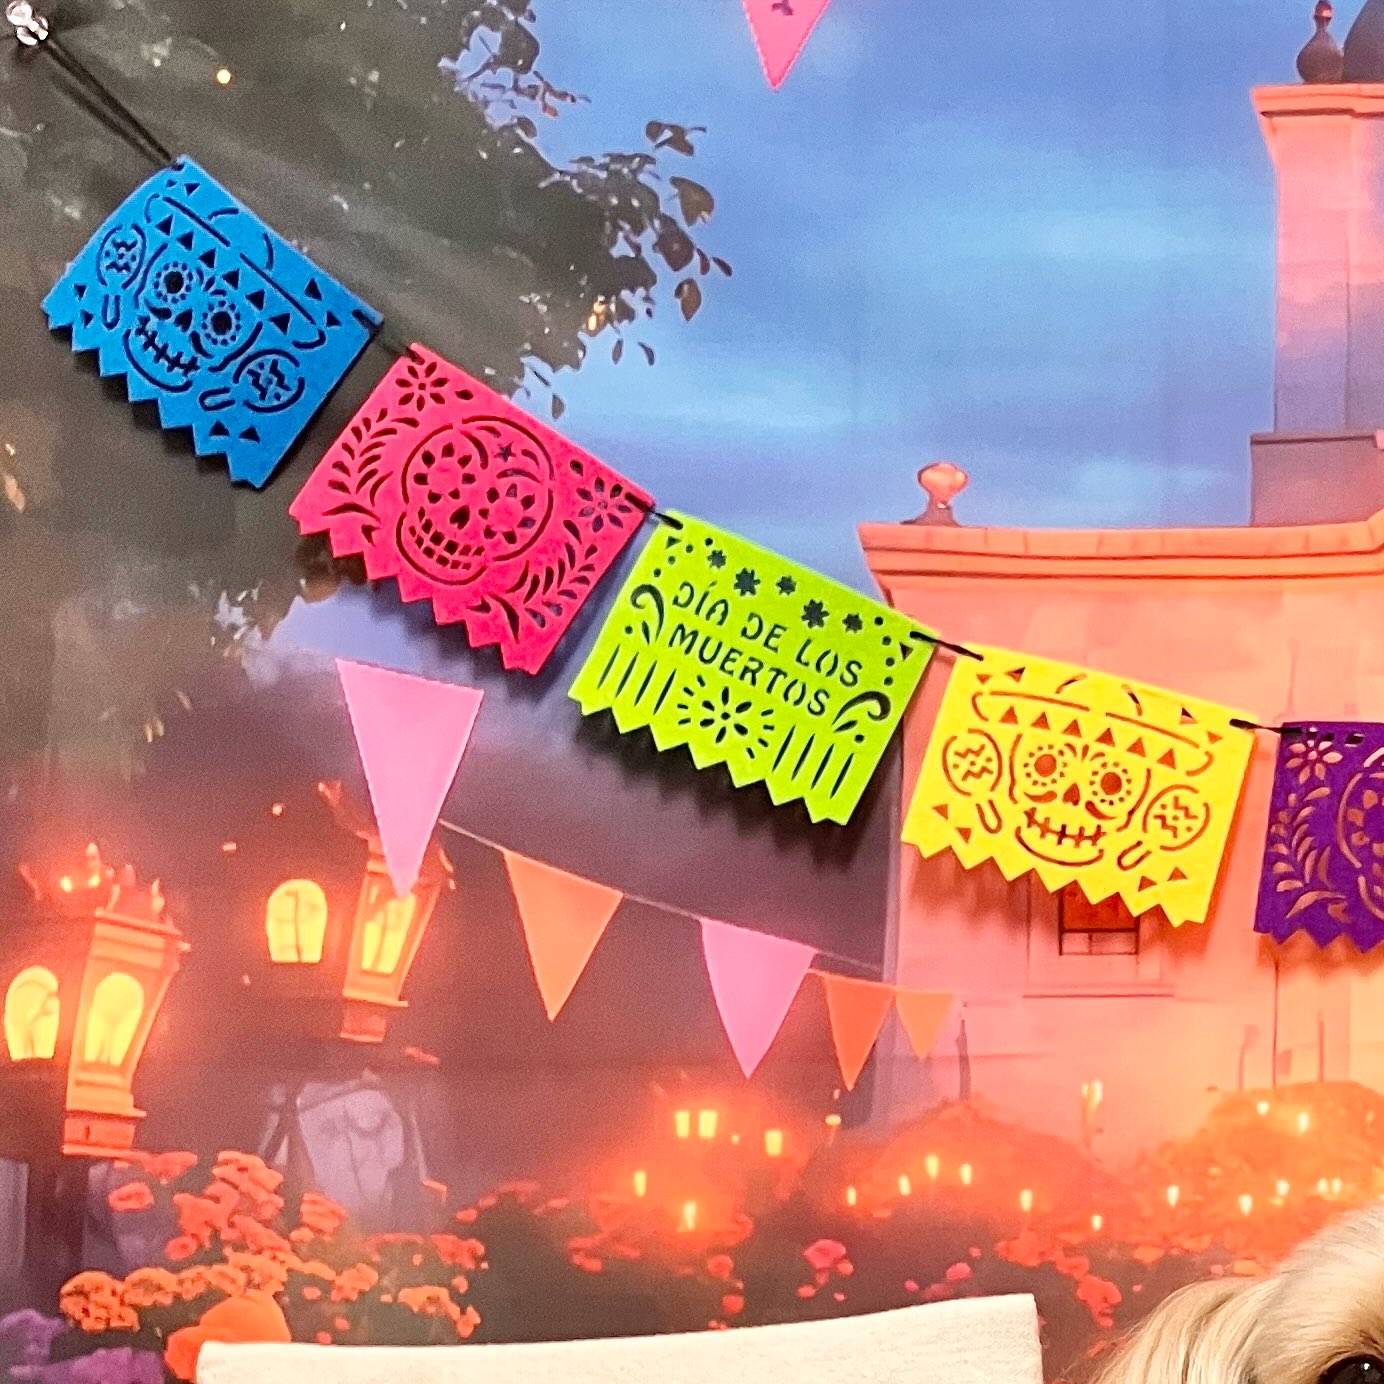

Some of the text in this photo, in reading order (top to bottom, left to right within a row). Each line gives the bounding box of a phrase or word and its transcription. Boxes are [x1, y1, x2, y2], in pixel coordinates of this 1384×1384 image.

[668, 623, 830, 716] MUERTOS
[741, 613, 787, 653] DE
[795, 639, 863, 688] LOS
